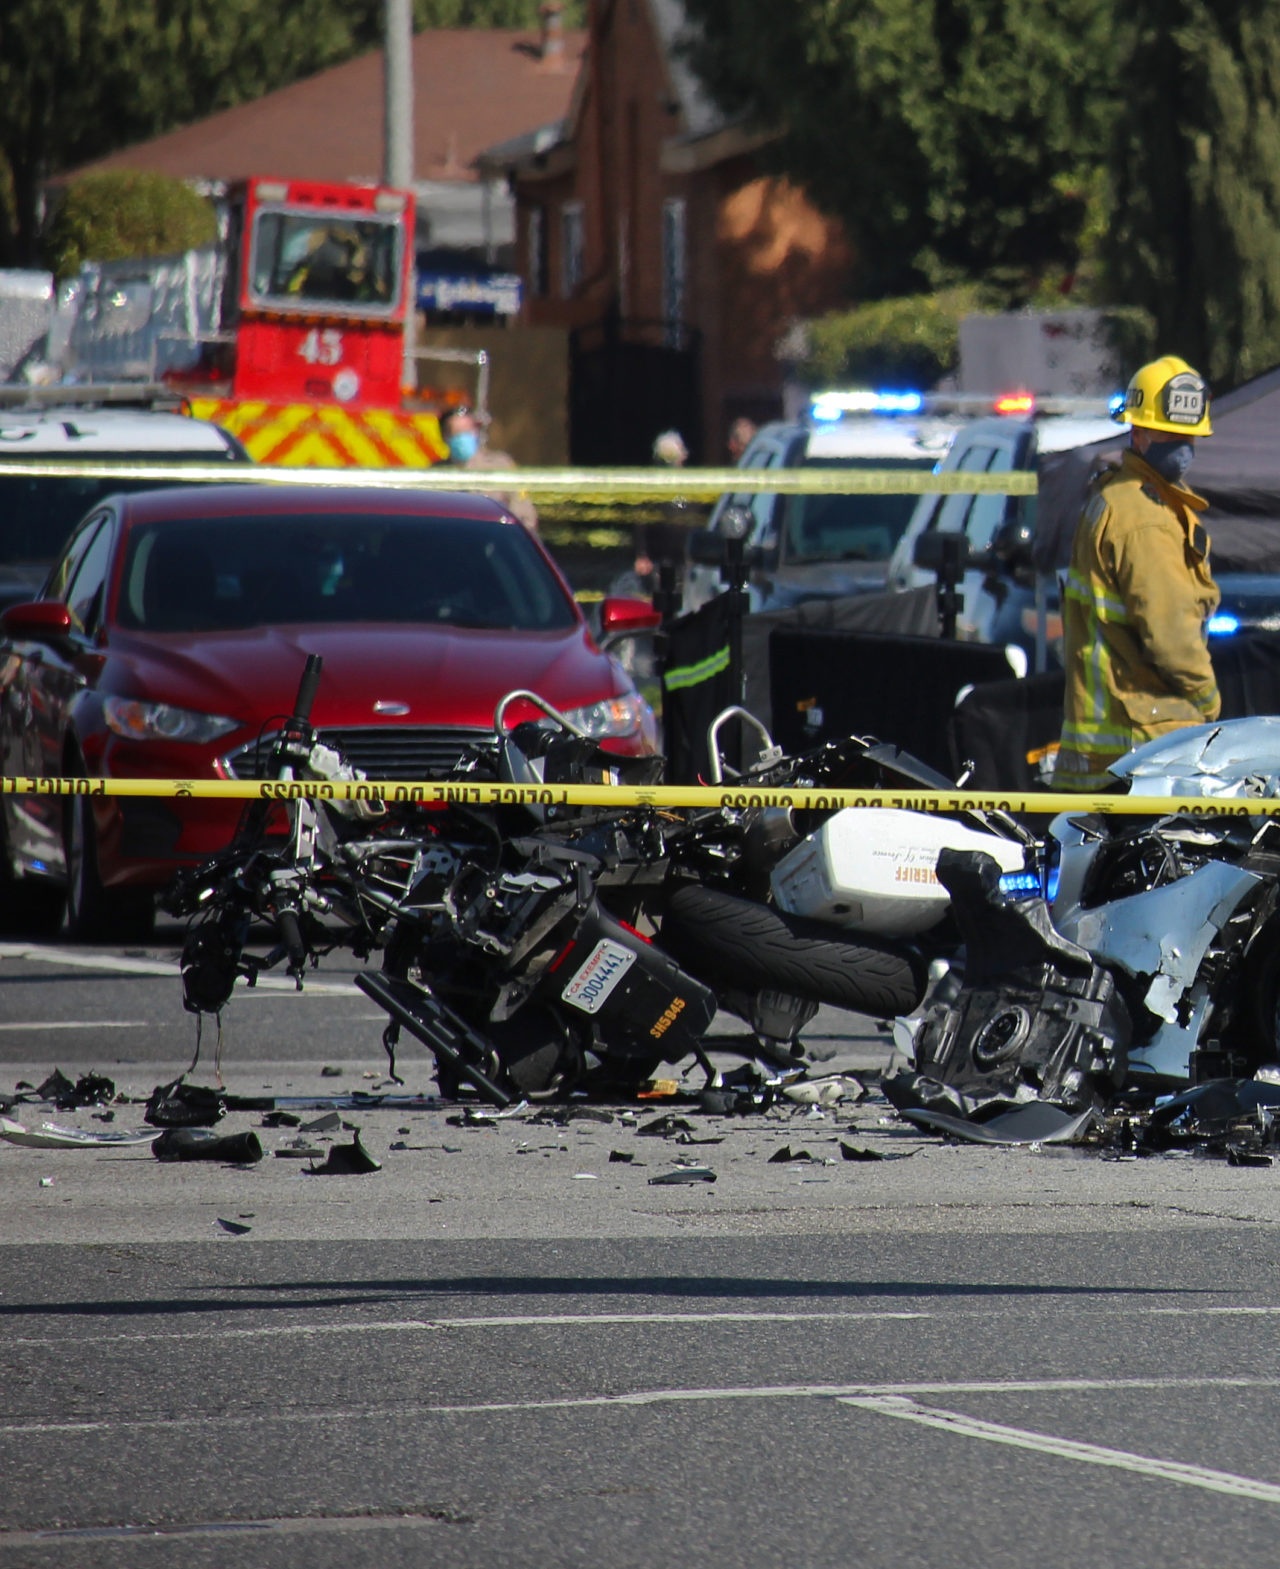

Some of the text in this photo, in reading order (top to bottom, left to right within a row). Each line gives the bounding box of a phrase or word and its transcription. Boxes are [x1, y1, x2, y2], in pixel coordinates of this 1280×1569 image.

[1173, 395, 1198, 409] PIO
[570, 949, 605, 993] CA EXEMPT
[578, 953, 625, 1003] 3004441
